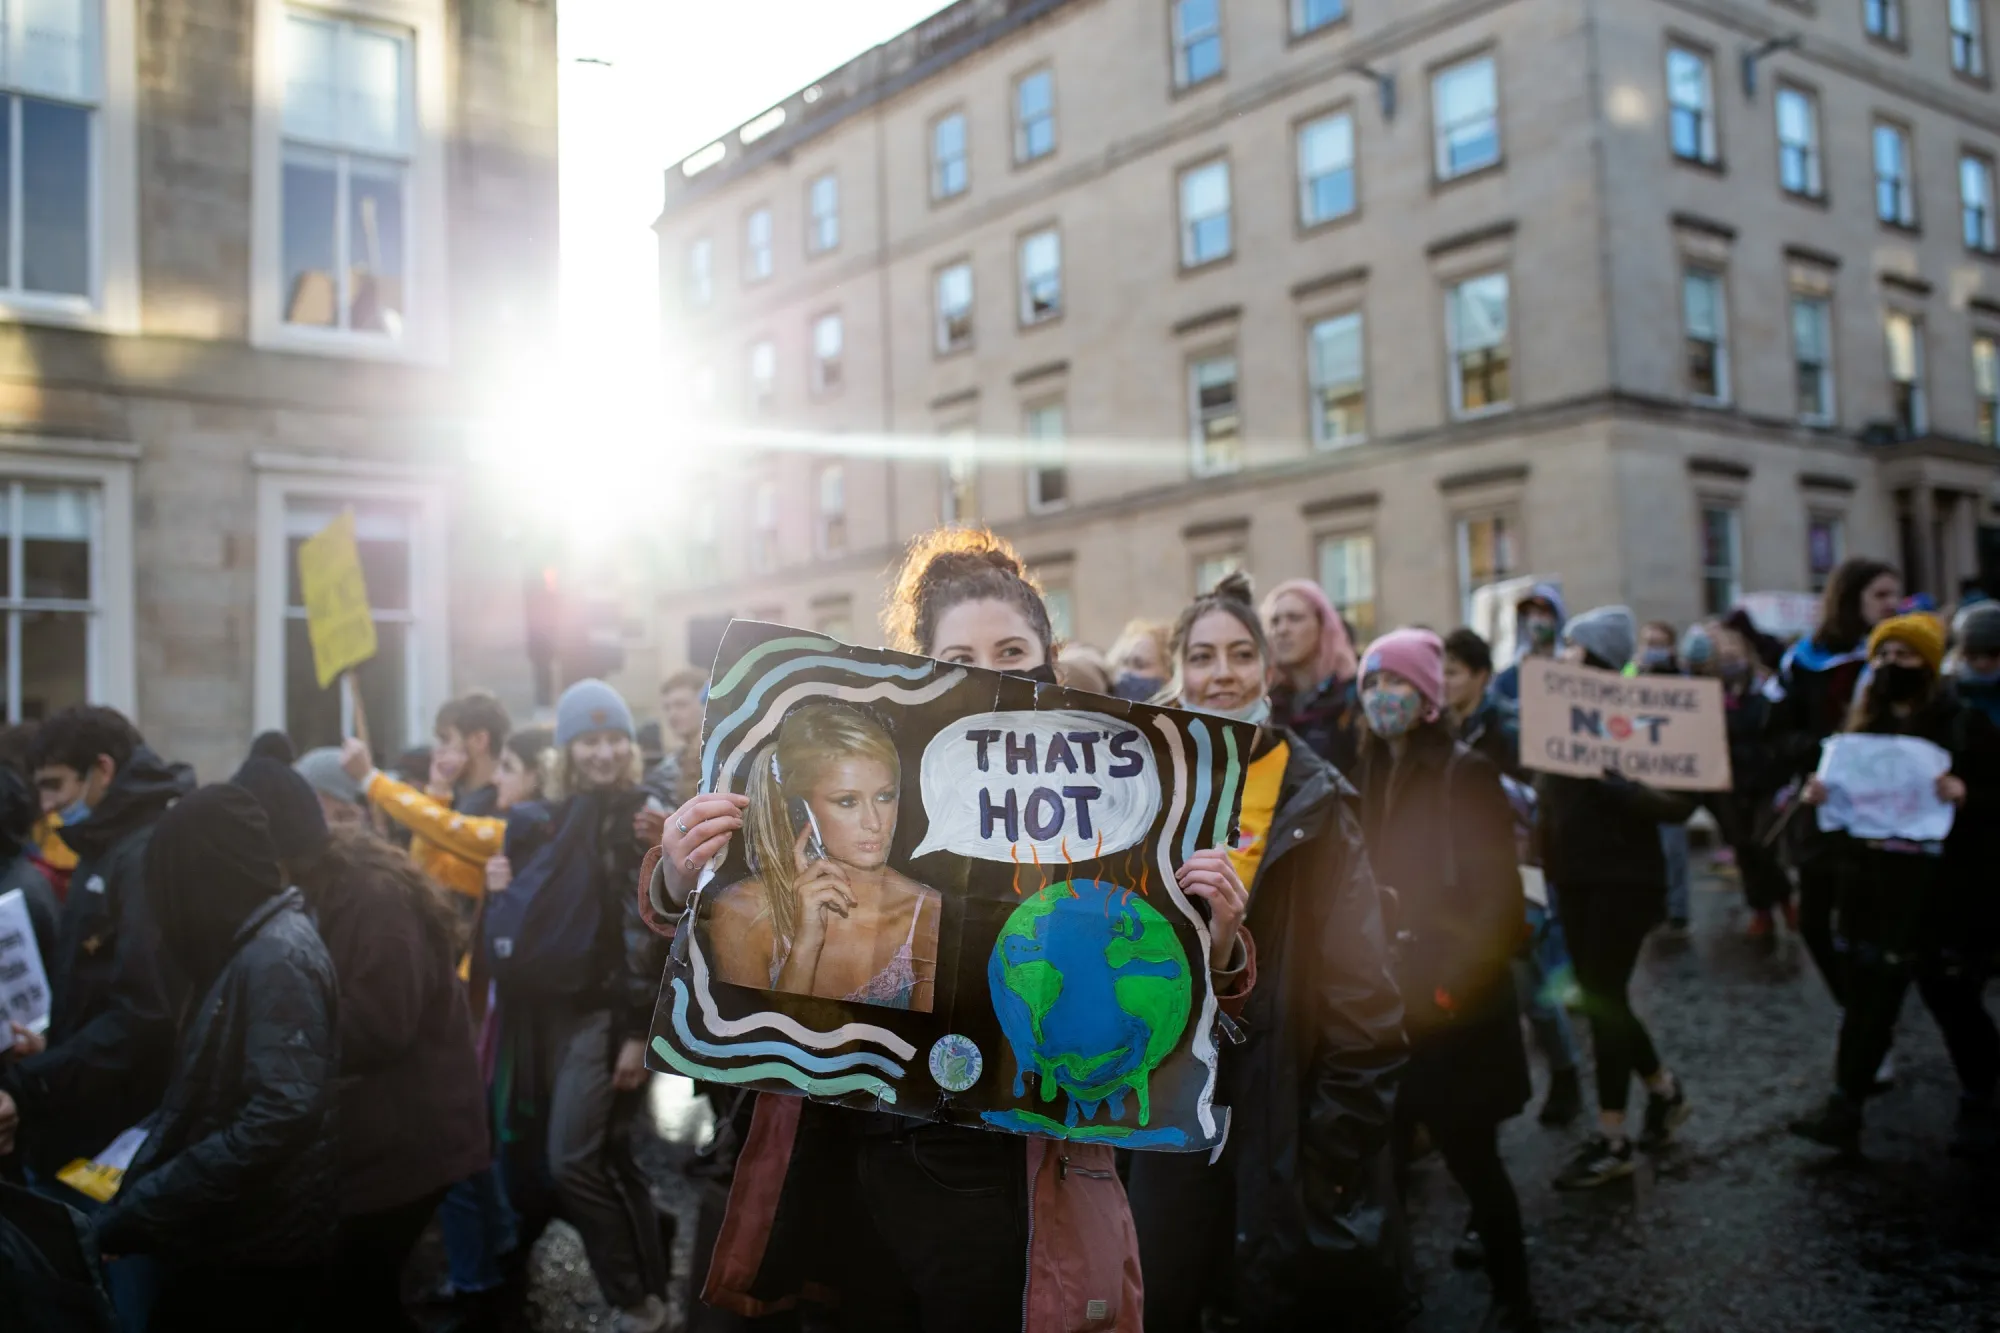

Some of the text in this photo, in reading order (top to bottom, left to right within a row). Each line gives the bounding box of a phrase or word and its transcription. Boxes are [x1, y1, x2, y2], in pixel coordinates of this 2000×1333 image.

[1570, 704, 1670, 745] NOT
[966, 730, 1144, 778] THAT'S
[979, 786, 1101, 842] HOT
